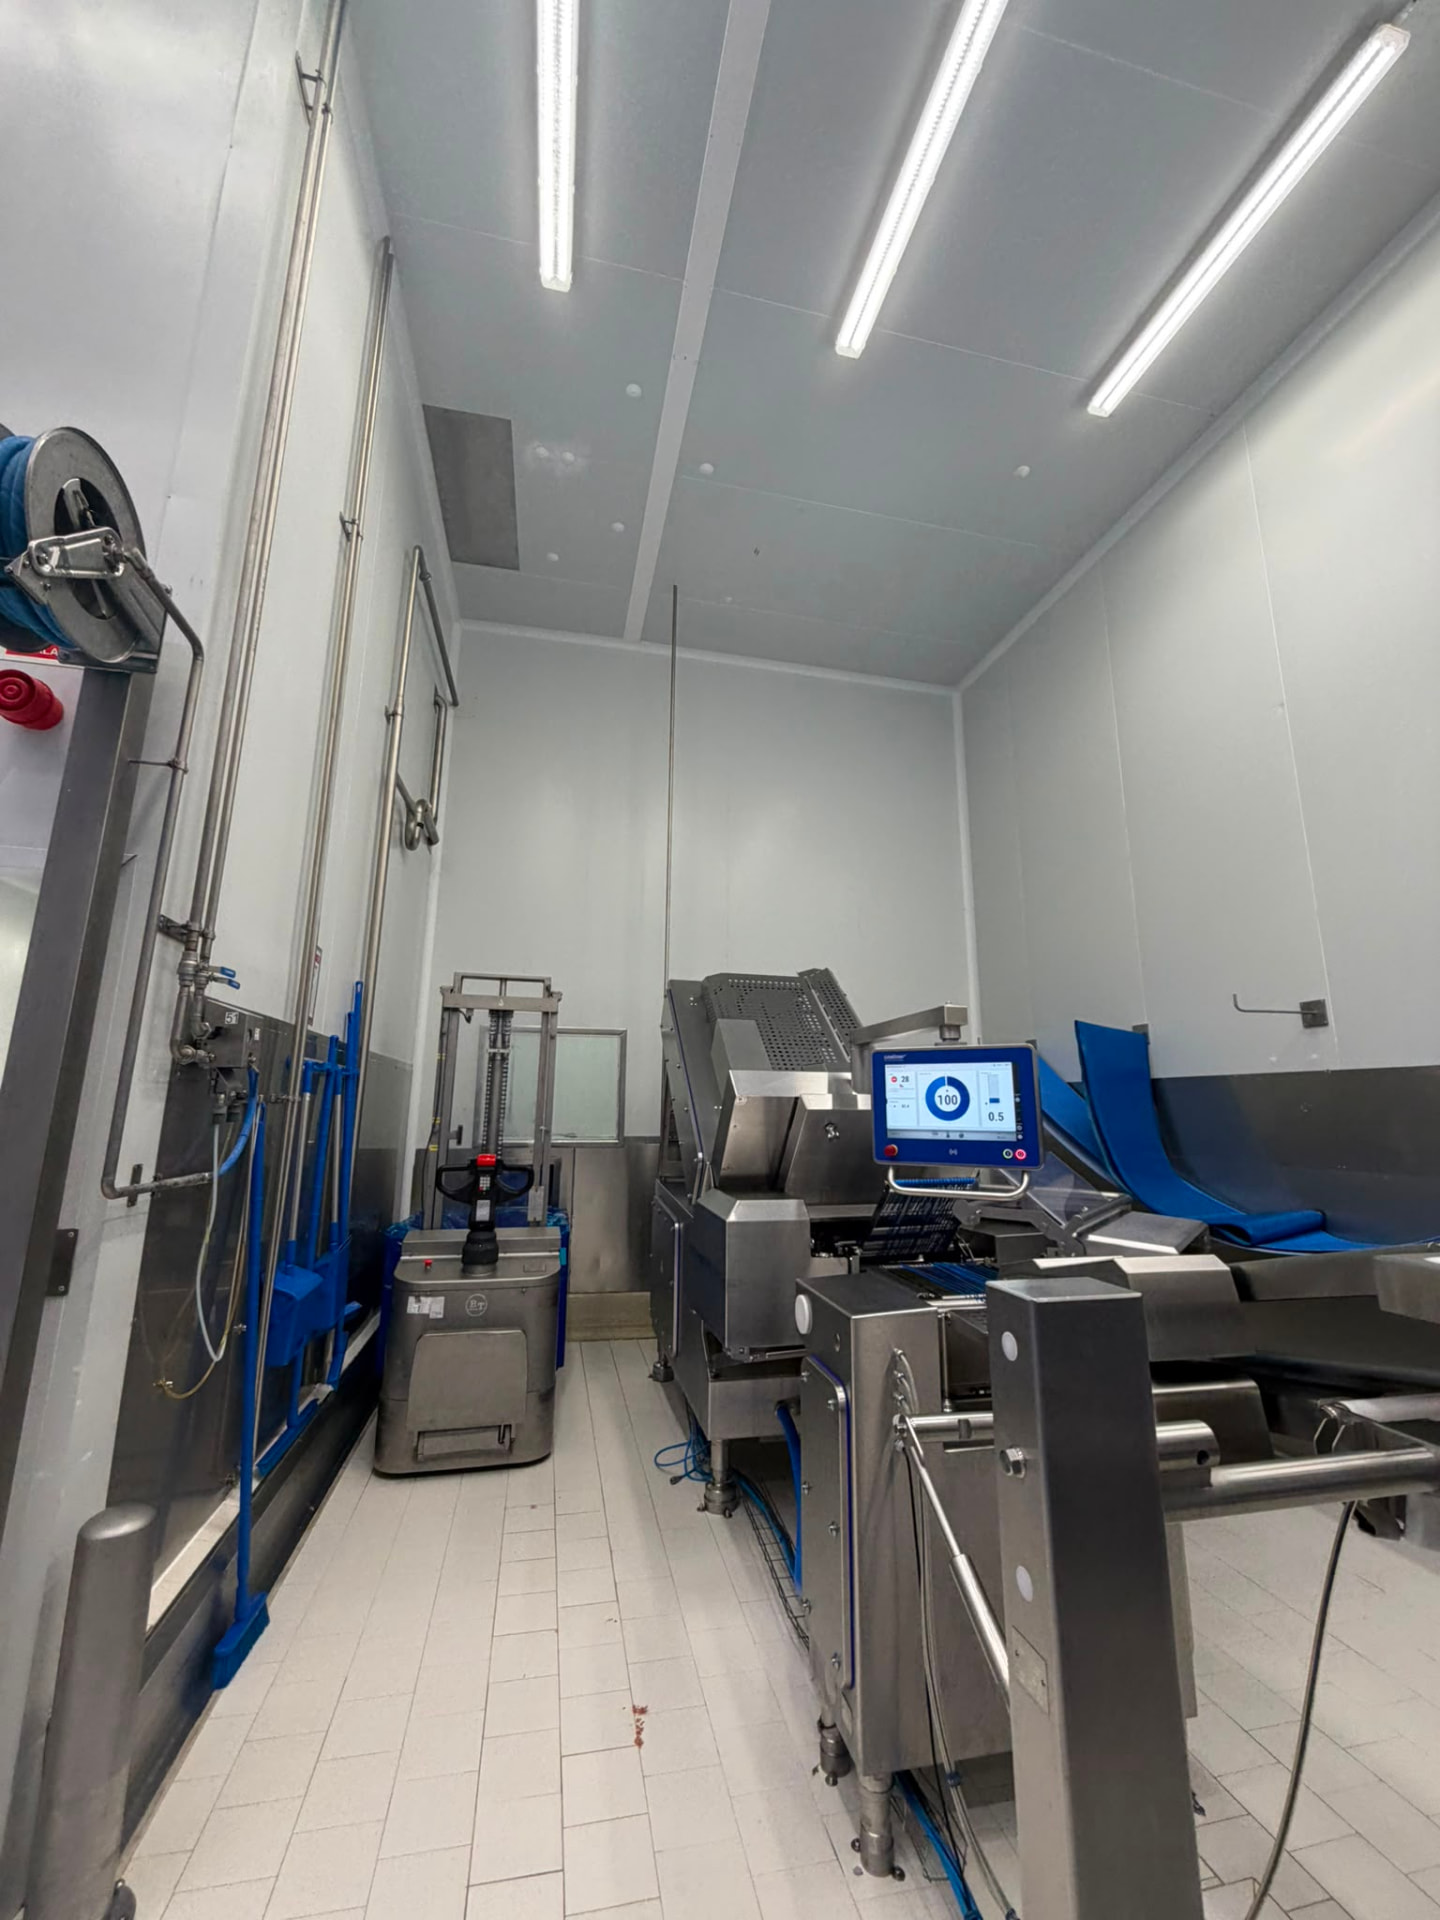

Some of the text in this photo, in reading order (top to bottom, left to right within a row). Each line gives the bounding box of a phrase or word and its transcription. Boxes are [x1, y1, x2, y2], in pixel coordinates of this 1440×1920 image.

[225, 1012, 239, 1024] 51
[901, 1075, 910, 1083] 28
[937, 1094, 958, 1106] 100
[988, 1111, 1005, 1122] 0.5
